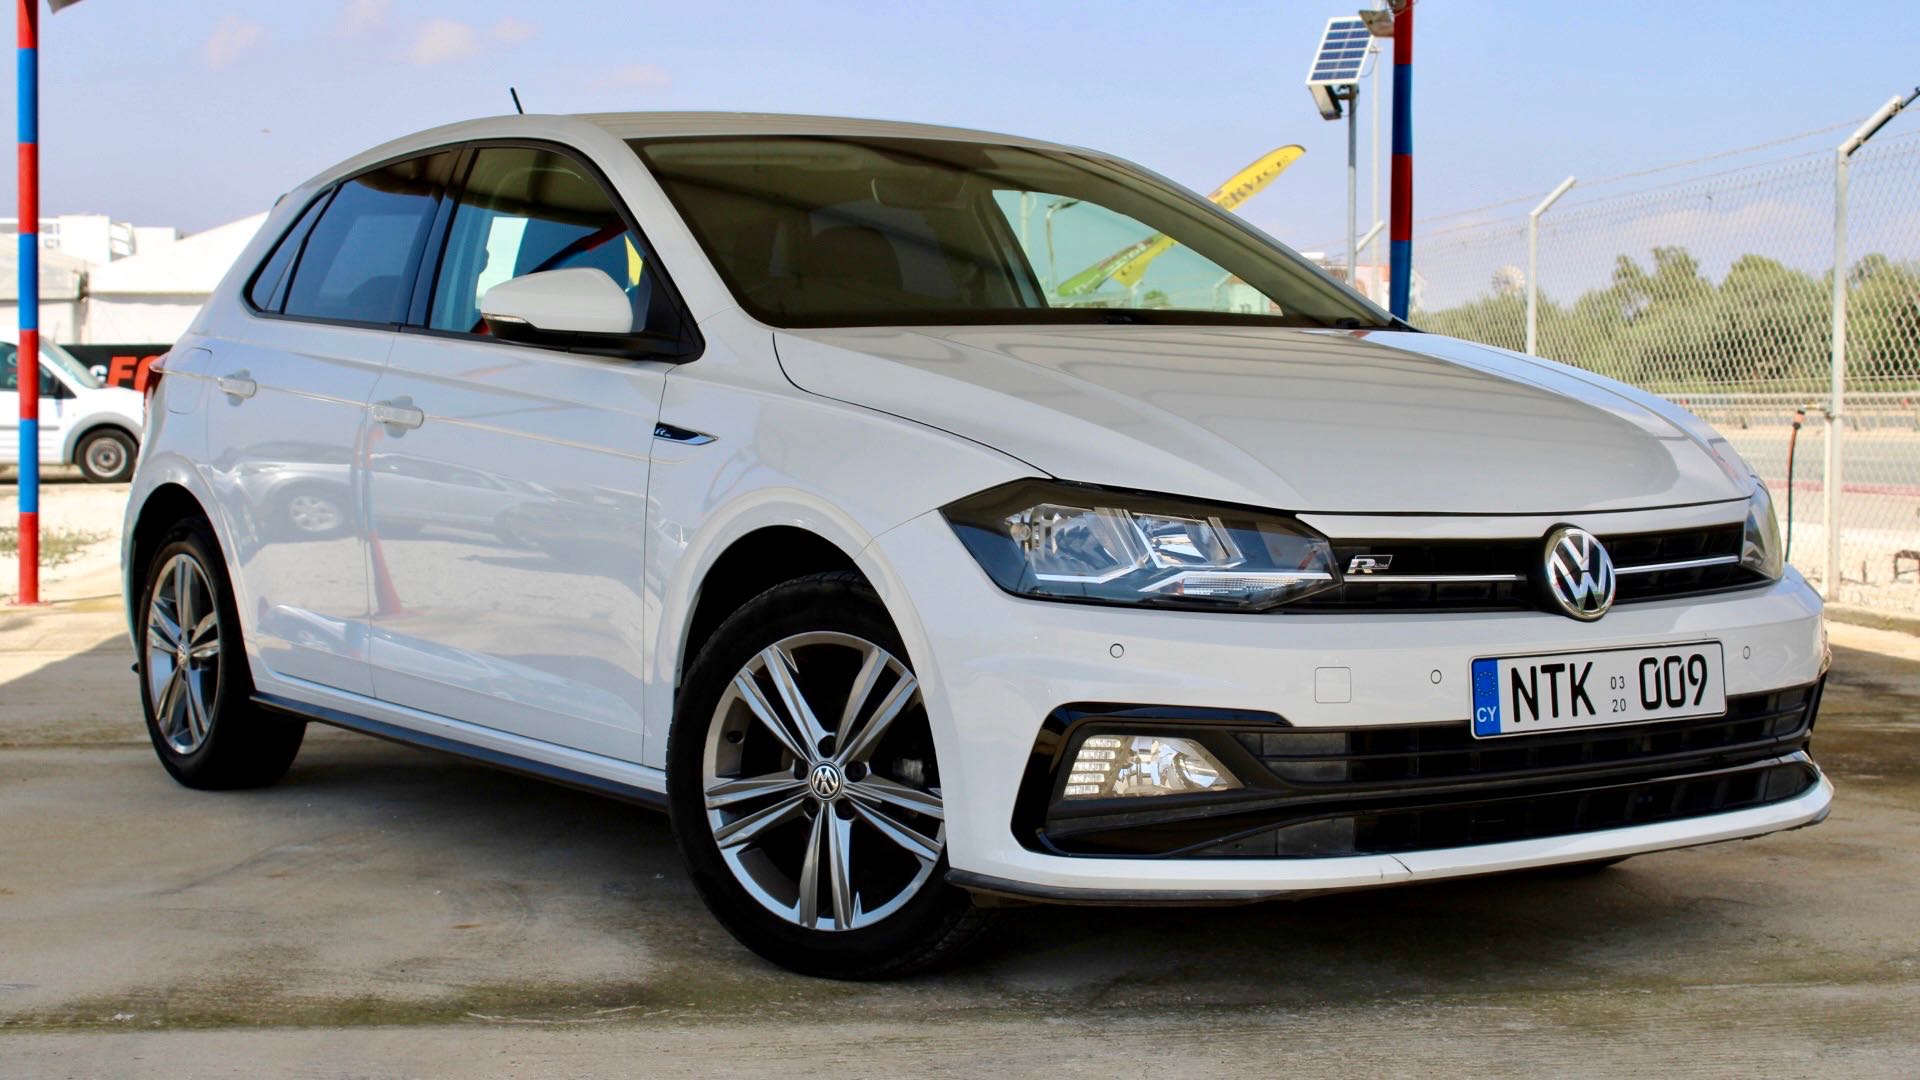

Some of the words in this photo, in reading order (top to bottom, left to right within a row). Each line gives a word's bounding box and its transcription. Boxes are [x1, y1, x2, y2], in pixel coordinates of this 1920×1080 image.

[1476, 706, 1497, 723] CY
[1510, 661, 1597, 723] NTK
[1638, 653, 1708, 711] 009
[1610, 676, 1626, 690] 03
[1612, 698, 1627, 713] 20
